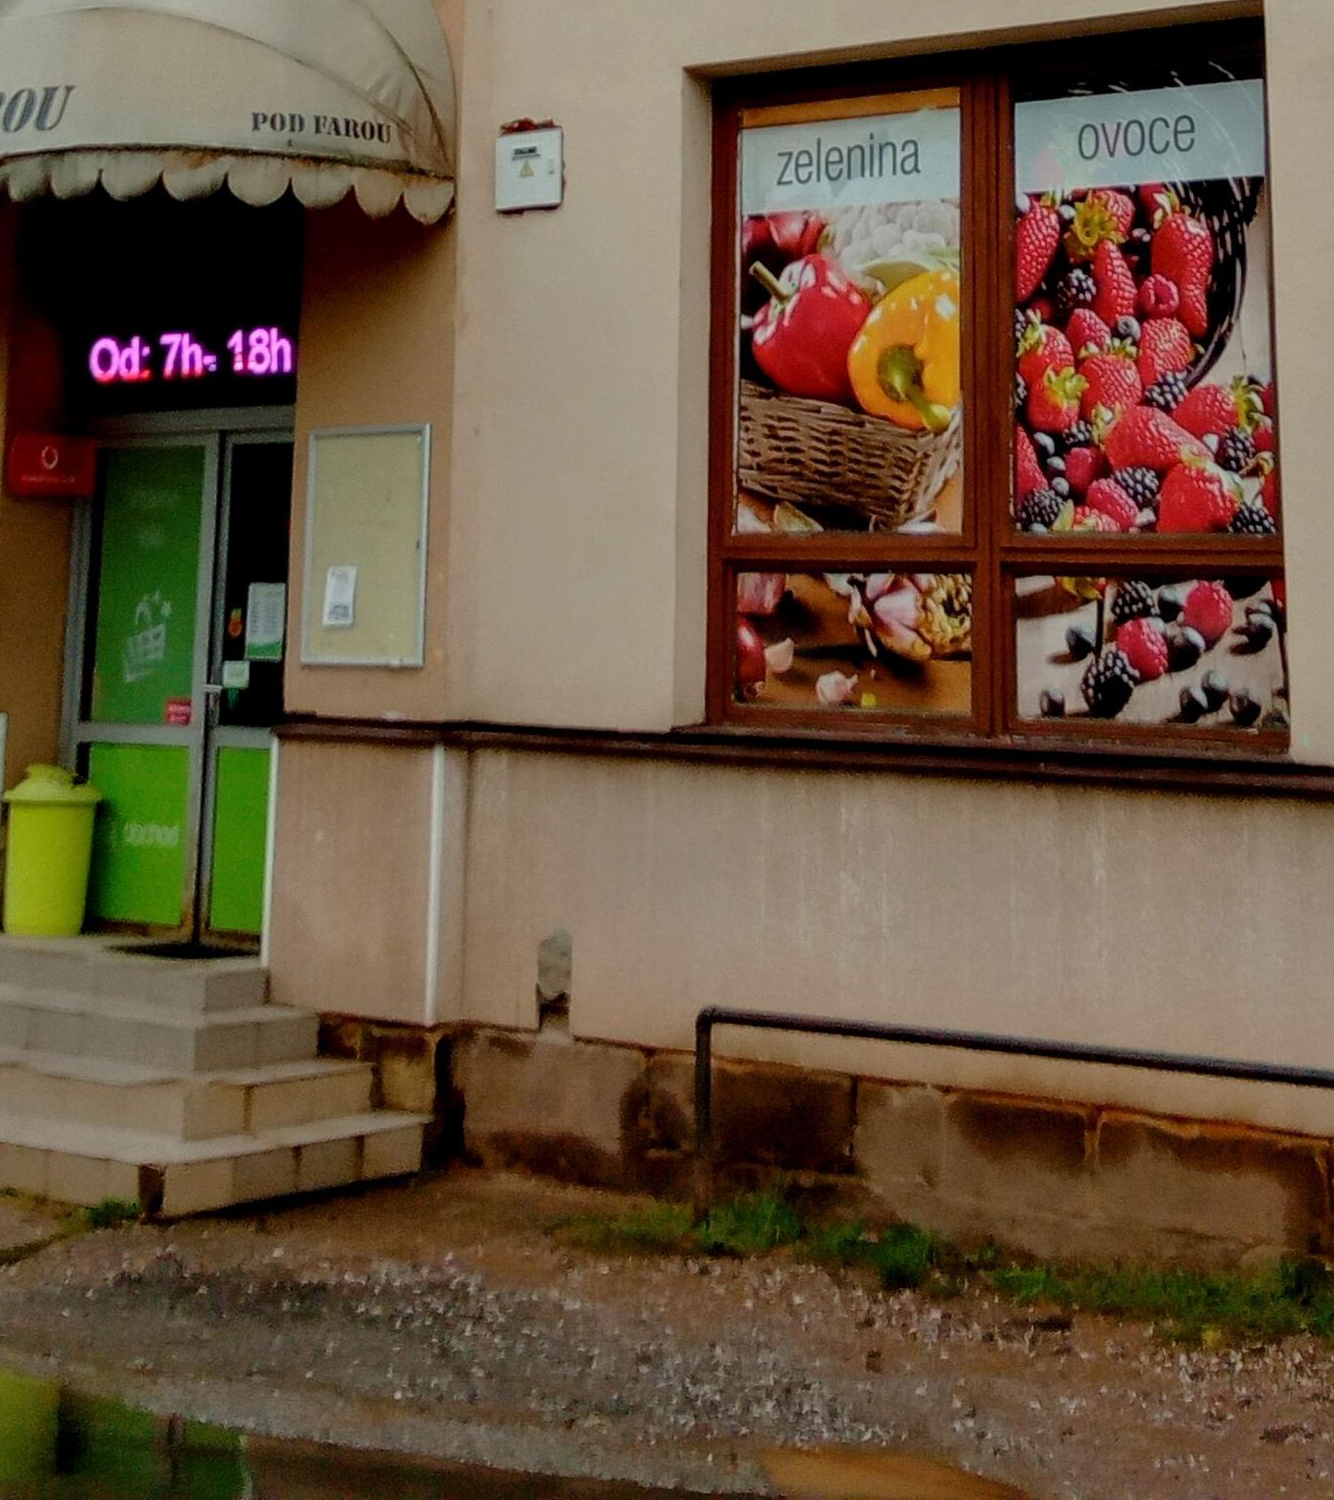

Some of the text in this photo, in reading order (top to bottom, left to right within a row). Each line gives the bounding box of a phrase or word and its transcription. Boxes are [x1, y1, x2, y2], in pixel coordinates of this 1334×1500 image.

[250, 110, 393, 145] POD FAROU
[1076, 113, 1196, 161] ovoce
[776, 131, 921, 187] zelenina
[88, 334, 153, 383] Od:
[225, 326, 294, 376] 18h
